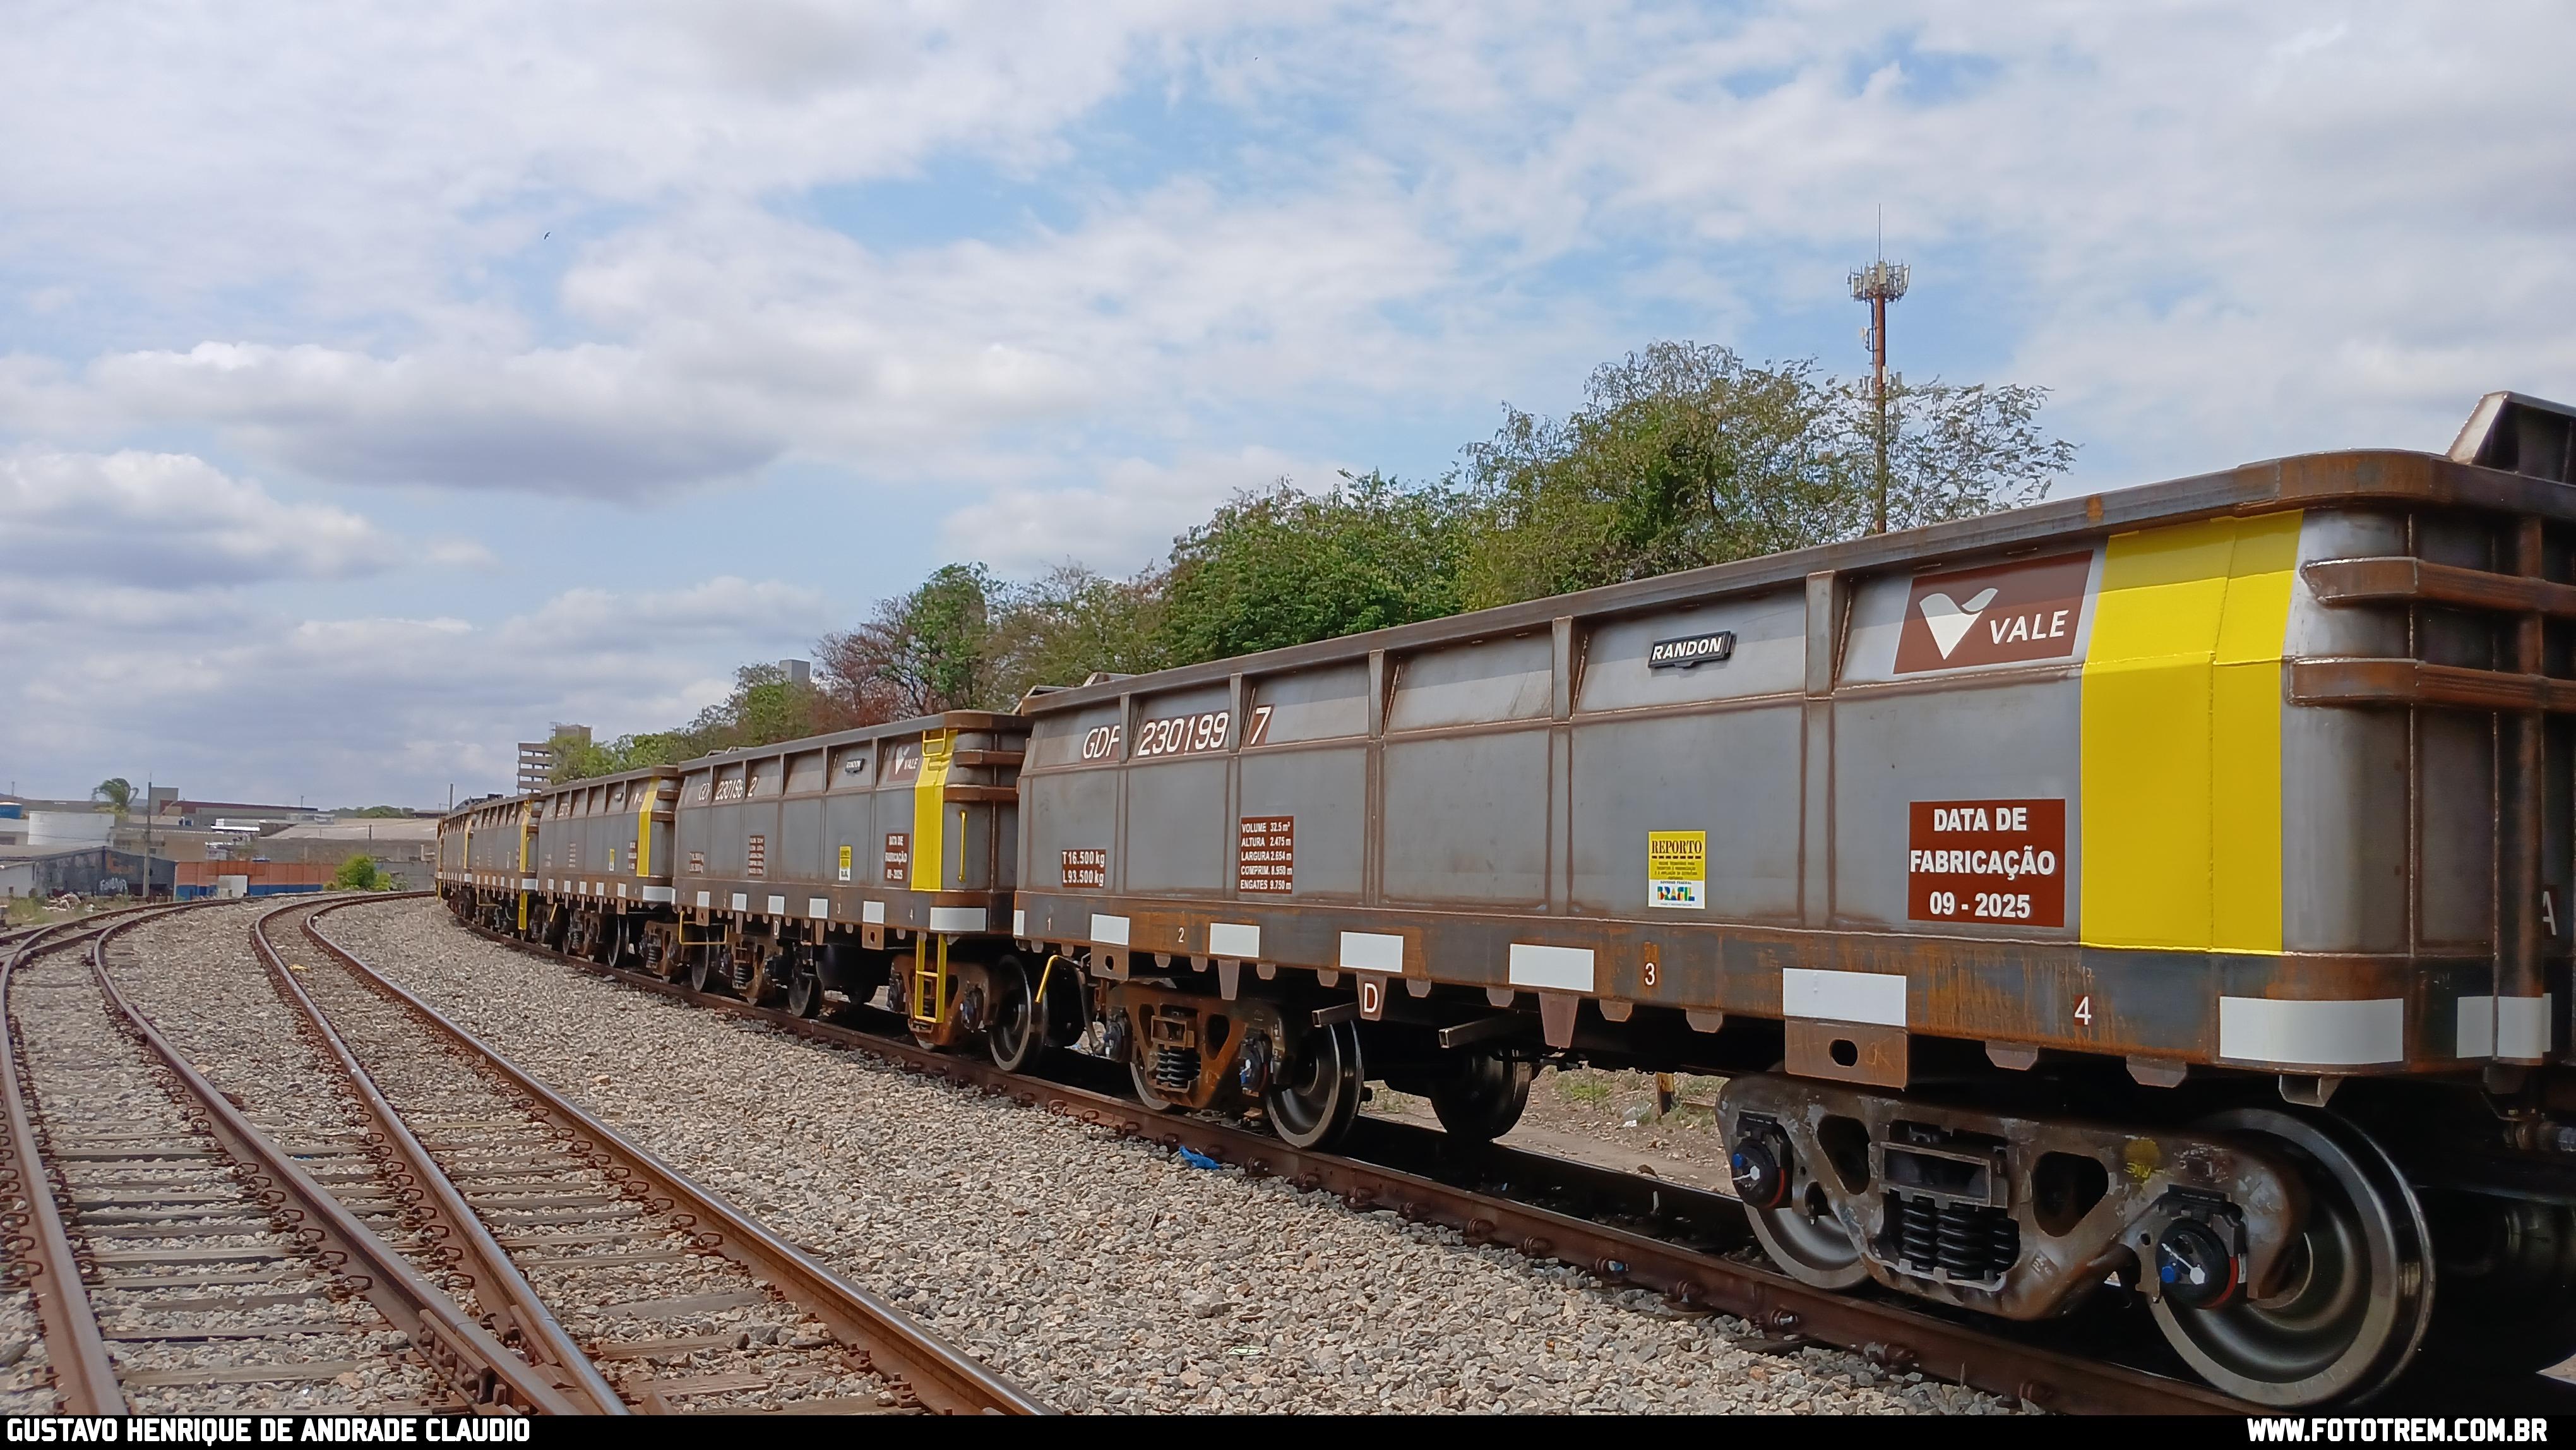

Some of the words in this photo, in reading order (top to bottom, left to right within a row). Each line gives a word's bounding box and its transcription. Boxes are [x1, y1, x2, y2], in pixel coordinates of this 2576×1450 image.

[1990, 610, 2069, 644] VALE
[1652, 637, 1722, 661] RANDON
[1138, 712, 1229, 756] 230199
[1250, 707, 1272, 745] 7
[1241, 823, 1267, 833] VOLUME
[1934, 808, 1989, 832] DATA
[1996, 807, 2027, 831] DE
[1241, 837, 1265, 847] ALTURA
[1270, 837, 1285, 847] 2.475
[1651, 840, 1702, 854] REPORTO
[1062, 851, 1067, 865] T
[1068, 851, 1094, 865] 16.500
[1095, 851, 1105, 868] kg
[1241, 851, 1270, 861] LARGURA
[1910, 845, 2055, 880] FABRICAÇÃO
[1063, 869, 1068, 883] L
[1068, 870, 1094, 884] 93.500
[1094, 870, 1104, 887] kg
[1241, 865, 1270, 875] COMPRIM.
[1240, 879, 1268, 890] ENGATES
[1270, 880, 1285, 890] 9.750
[1657, 886, 1695, 901] BRASIL
[1929, 891, 1955, 915] 09
[1974, 892, 2030, 919] 2025
[2542, 890, 2557, 935] A
[1047, 917, 1051, 932] 1
[1178, 926, 1185, 943] 2
[1645, 962, 1655, 986] 3
[1364, 983, 1378, 1013] D
[2074, 996, 2092, 1026] 4
